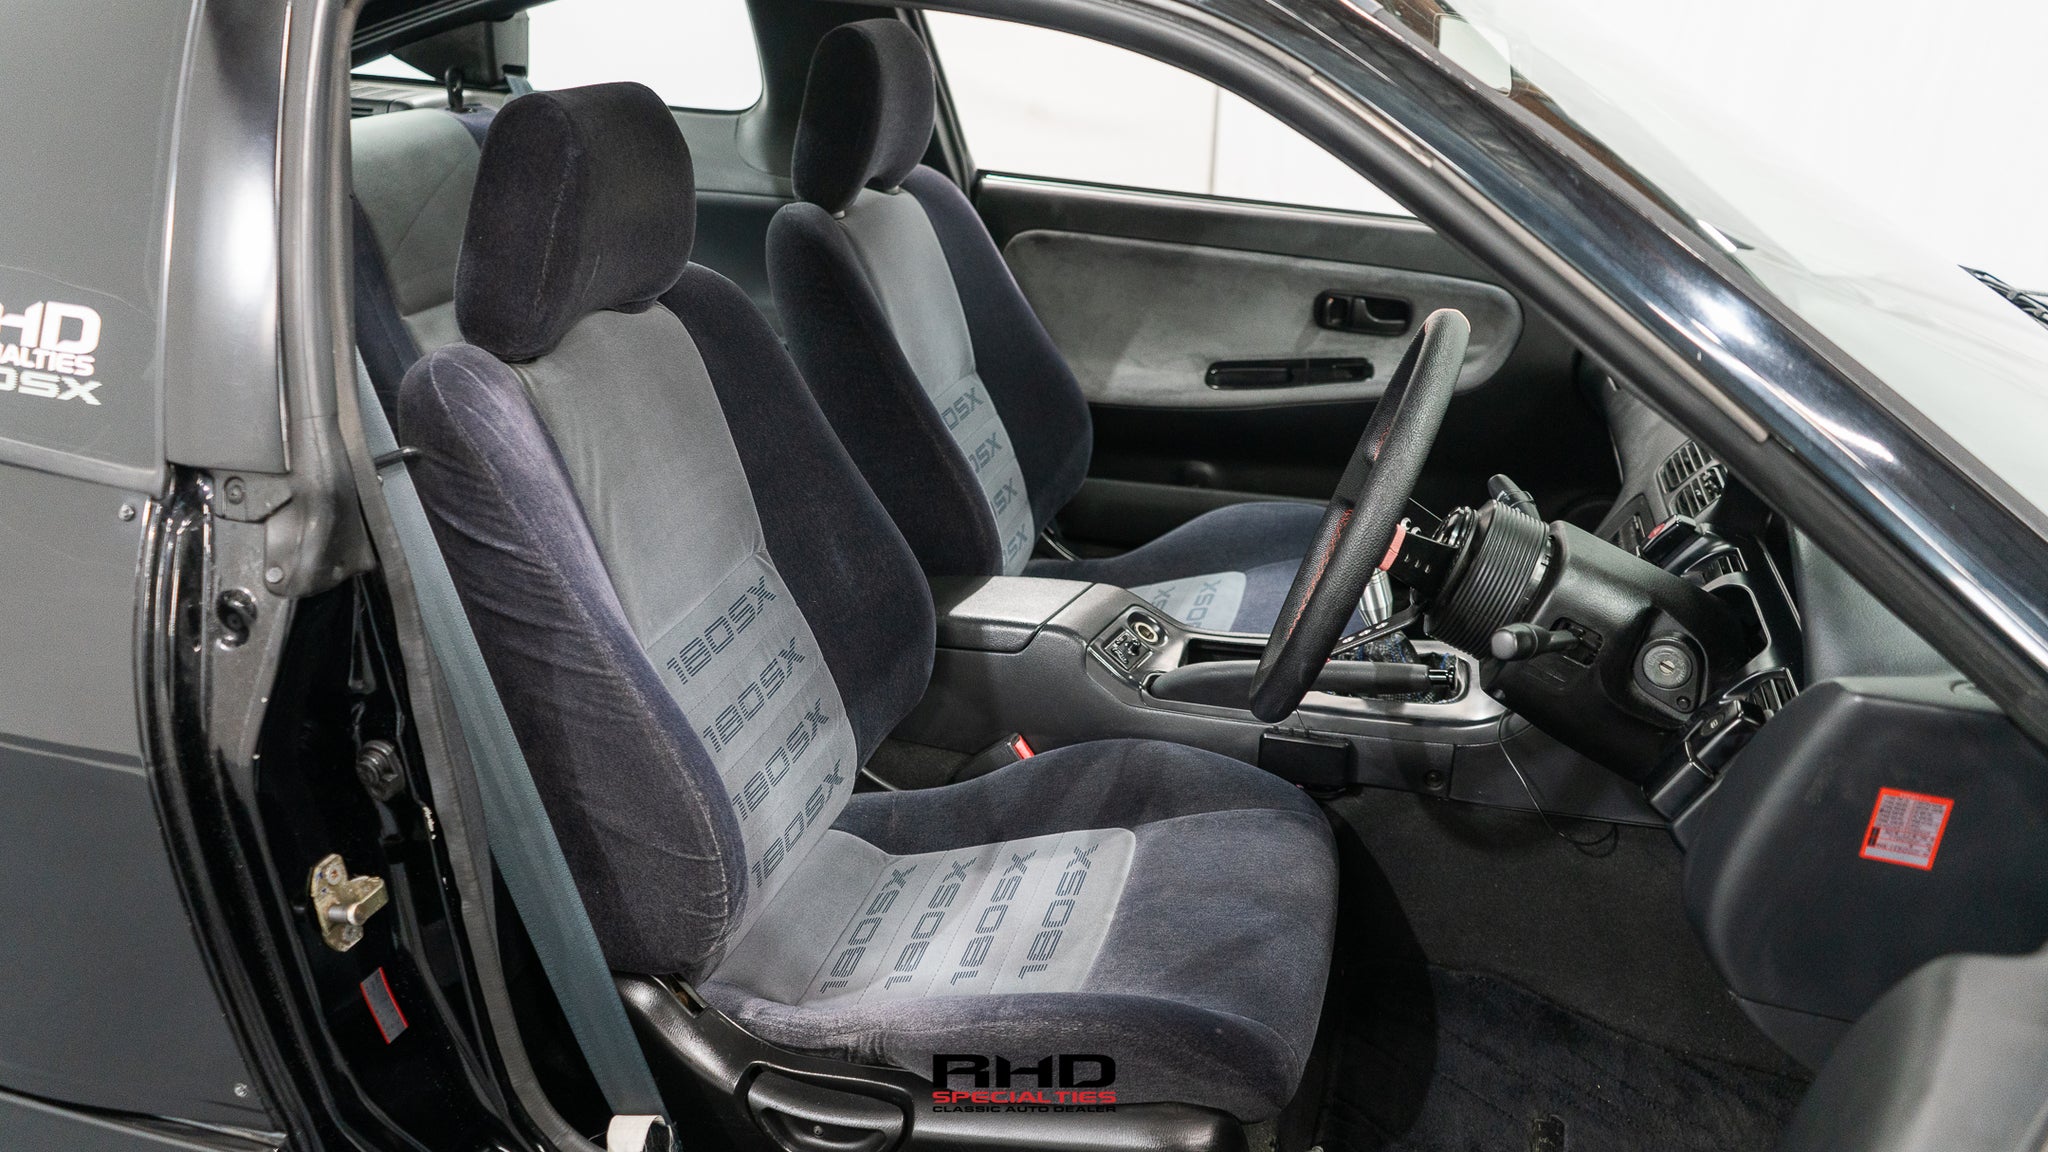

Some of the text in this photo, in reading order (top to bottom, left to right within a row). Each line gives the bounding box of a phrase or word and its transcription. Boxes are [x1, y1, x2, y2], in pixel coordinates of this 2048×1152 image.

[667, 576, 776, 685] 180SX
[703, 637, 805, 753] 180SX
[732, 697, 829, 821] 180SX
[751, 758, 844, 888] 180SX
[820, 864, 917, 993] 180SX
[884, 857, 977, 990] 180SX
[950, 849, 1037, 986] 180SX
[1018, 843, 1099, 979] 180SX
